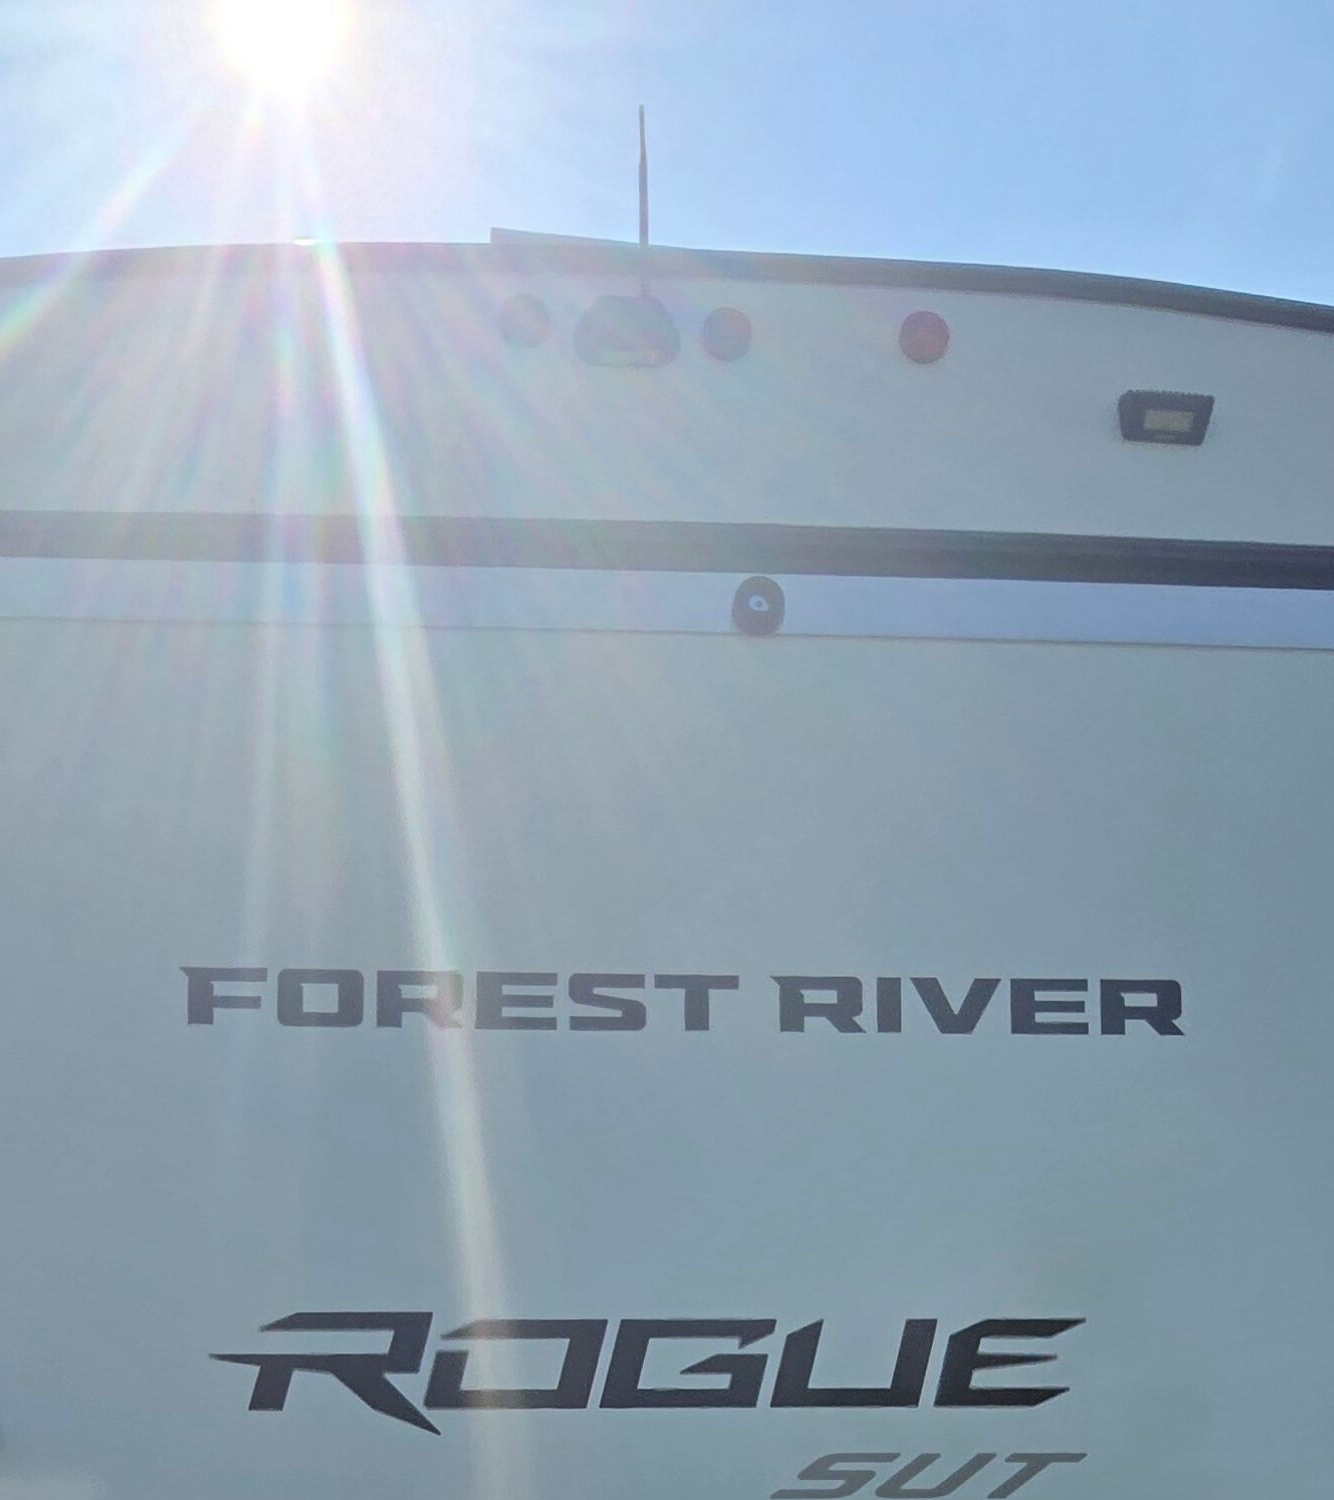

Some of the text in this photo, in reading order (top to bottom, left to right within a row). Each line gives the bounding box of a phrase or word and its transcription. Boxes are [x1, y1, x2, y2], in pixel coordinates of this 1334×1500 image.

[178, 966, 1186, 1036] FOREST RIVER
[209, 1311, 1087, 1435] ROGUE
[770, 1452, 1086, 1500] SUT
